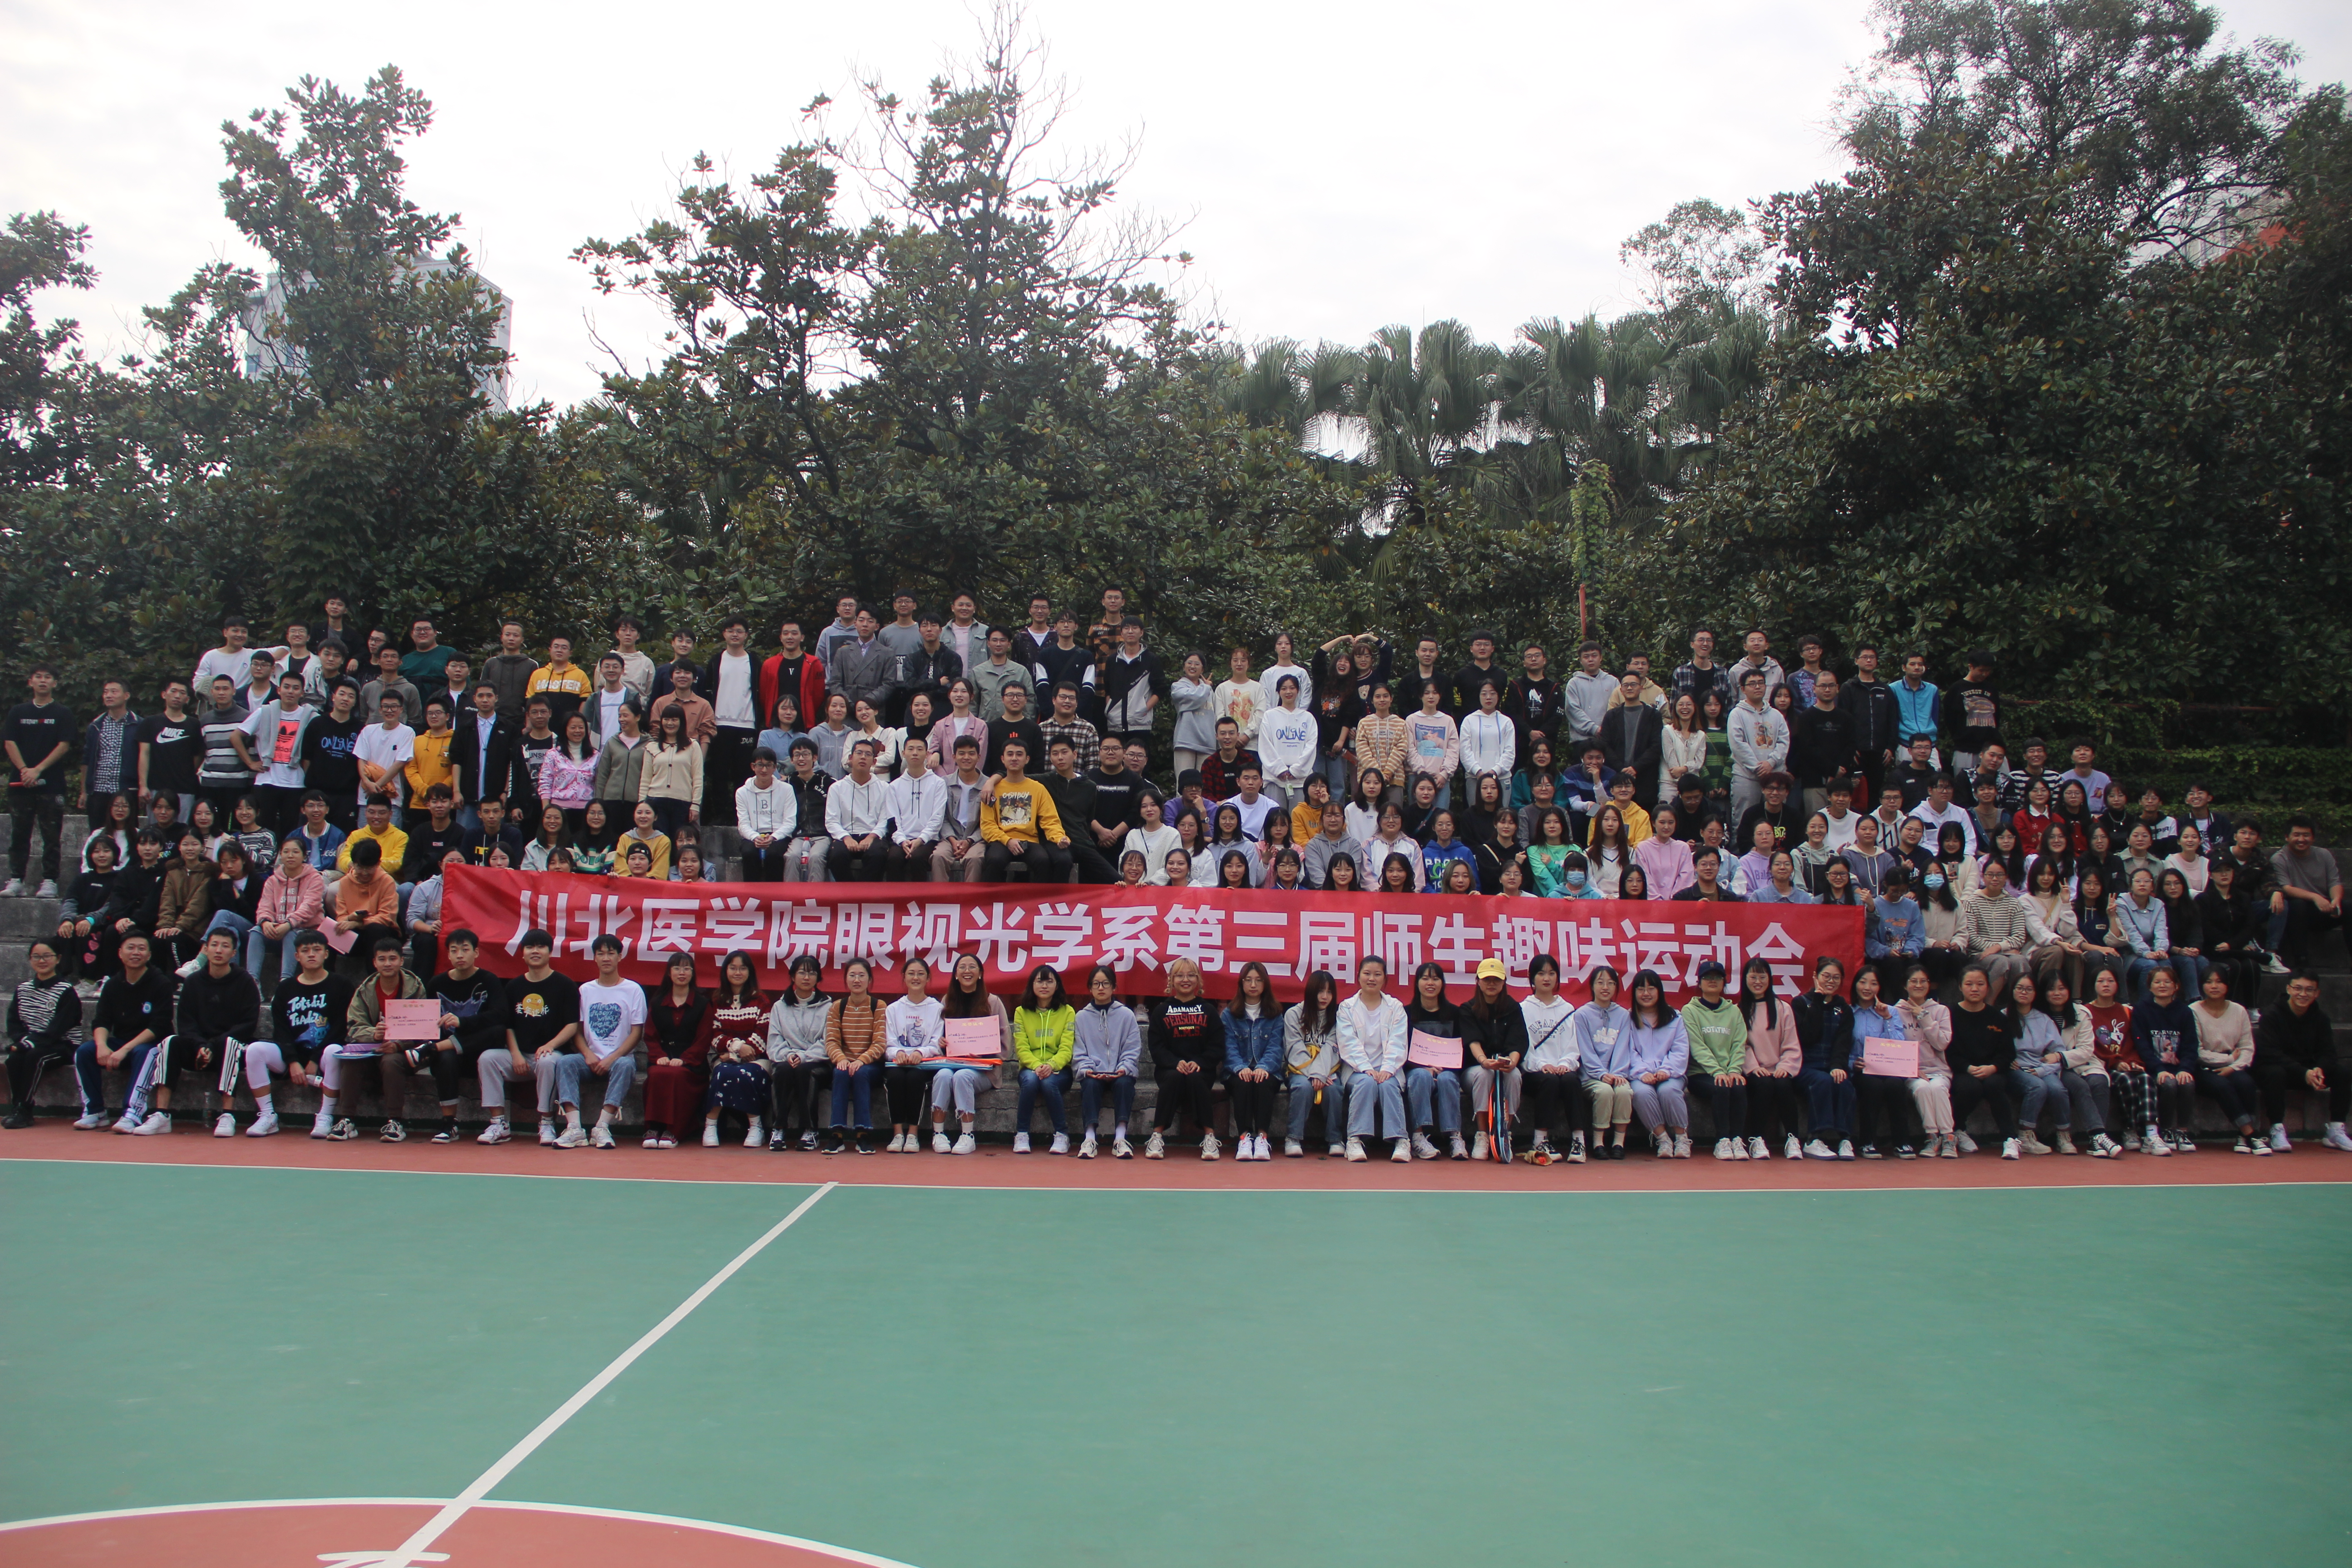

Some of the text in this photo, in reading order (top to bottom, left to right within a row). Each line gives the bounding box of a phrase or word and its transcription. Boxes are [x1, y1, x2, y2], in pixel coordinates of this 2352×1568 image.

[536, 679, 581, 691] MASTER
[162, 727, 185, 738] NIKE
[1276, 725, 1306, 741] ONLINE
[321, 735, 355, 752] ONLINE
[761, 799, 768, 809] B
[505, 890, 1805, 997] 川北医学院眼视光学系第三届师生趣味运动会
[1167, 1004, 1202, 1014] ADAMANCY
[1163, 1014, 1208, 1029] PERSONAL
